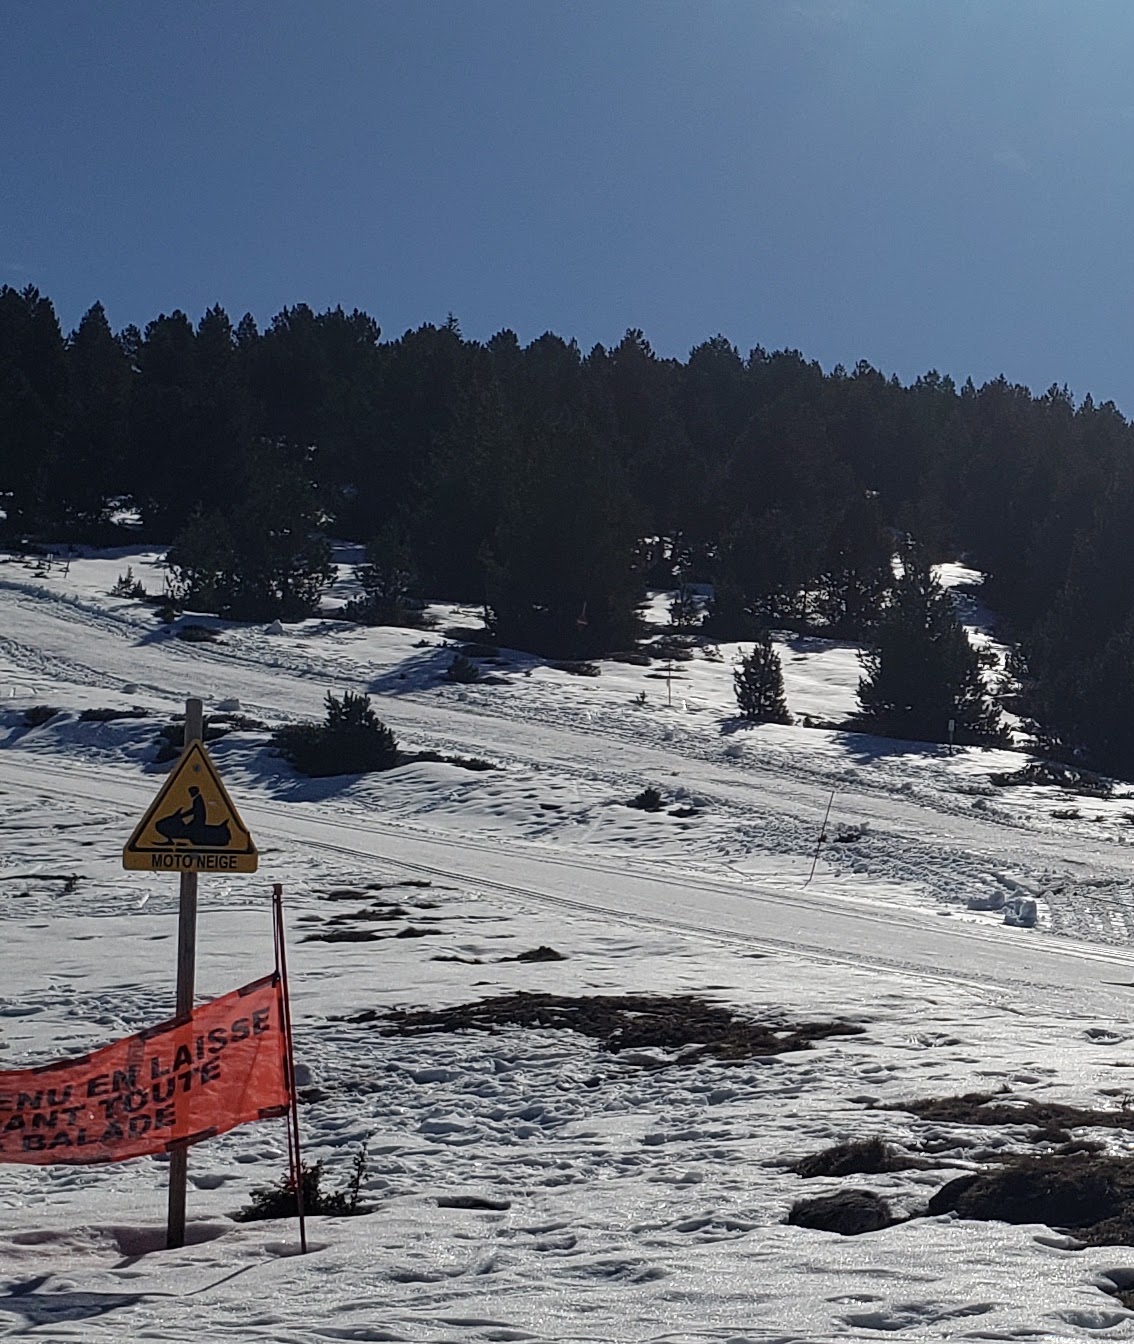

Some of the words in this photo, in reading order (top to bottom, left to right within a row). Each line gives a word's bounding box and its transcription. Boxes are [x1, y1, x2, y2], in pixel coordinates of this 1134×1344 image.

[151, 854, 193, 868] MOTO
[196, 855, 237, 869] NEIGE
[87, 1064, 143, 1098] EN
[151, 1007, 270, 1080] LAISSE
[99, 1056, 221, 1119] TOUTE
[22, 1103, 177, 1152] BALADE
